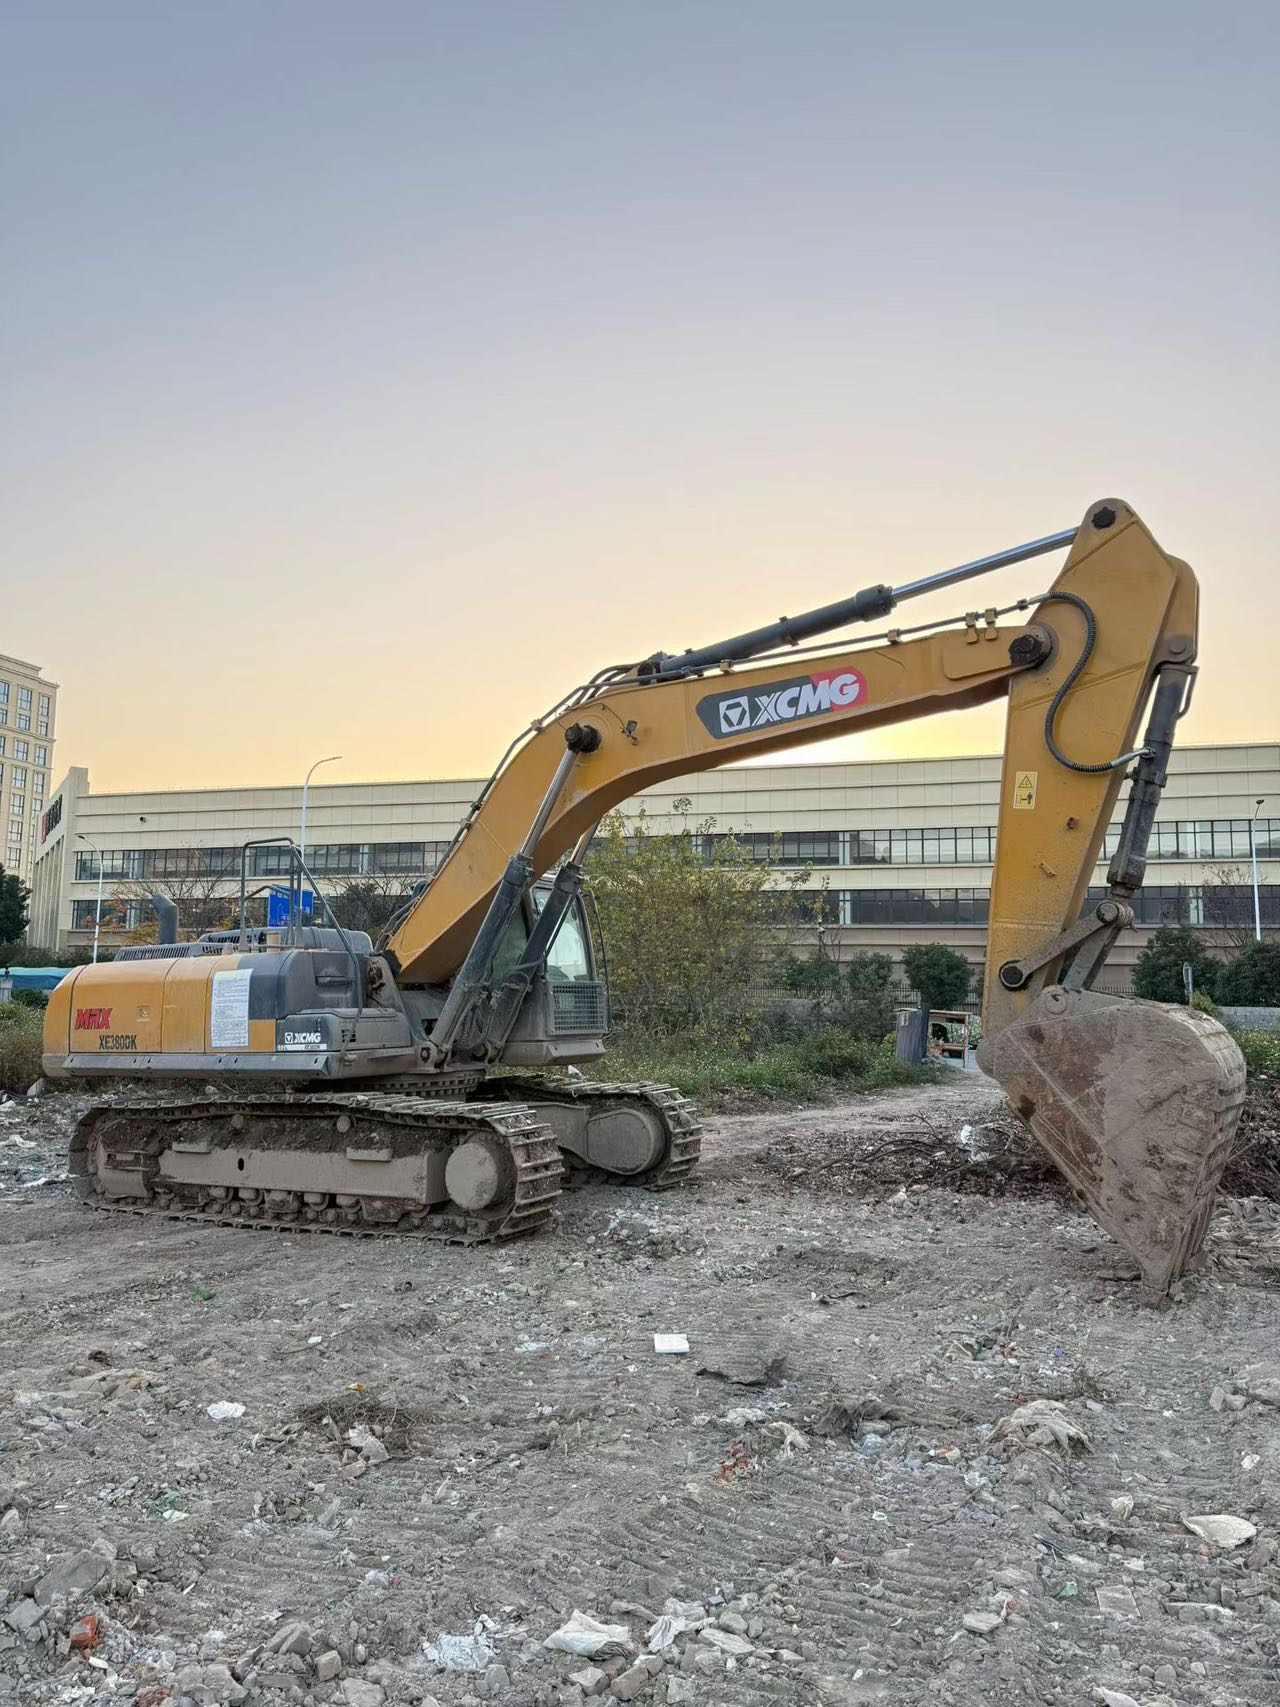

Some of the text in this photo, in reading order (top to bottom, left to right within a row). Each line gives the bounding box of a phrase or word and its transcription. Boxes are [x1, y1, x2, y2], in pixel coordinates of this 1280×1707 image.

[752, 674, 859, 726] XCMG
[99, 1034, 137, 1050] XE380DK
[294, 1032, 321, 1043] XCMG
